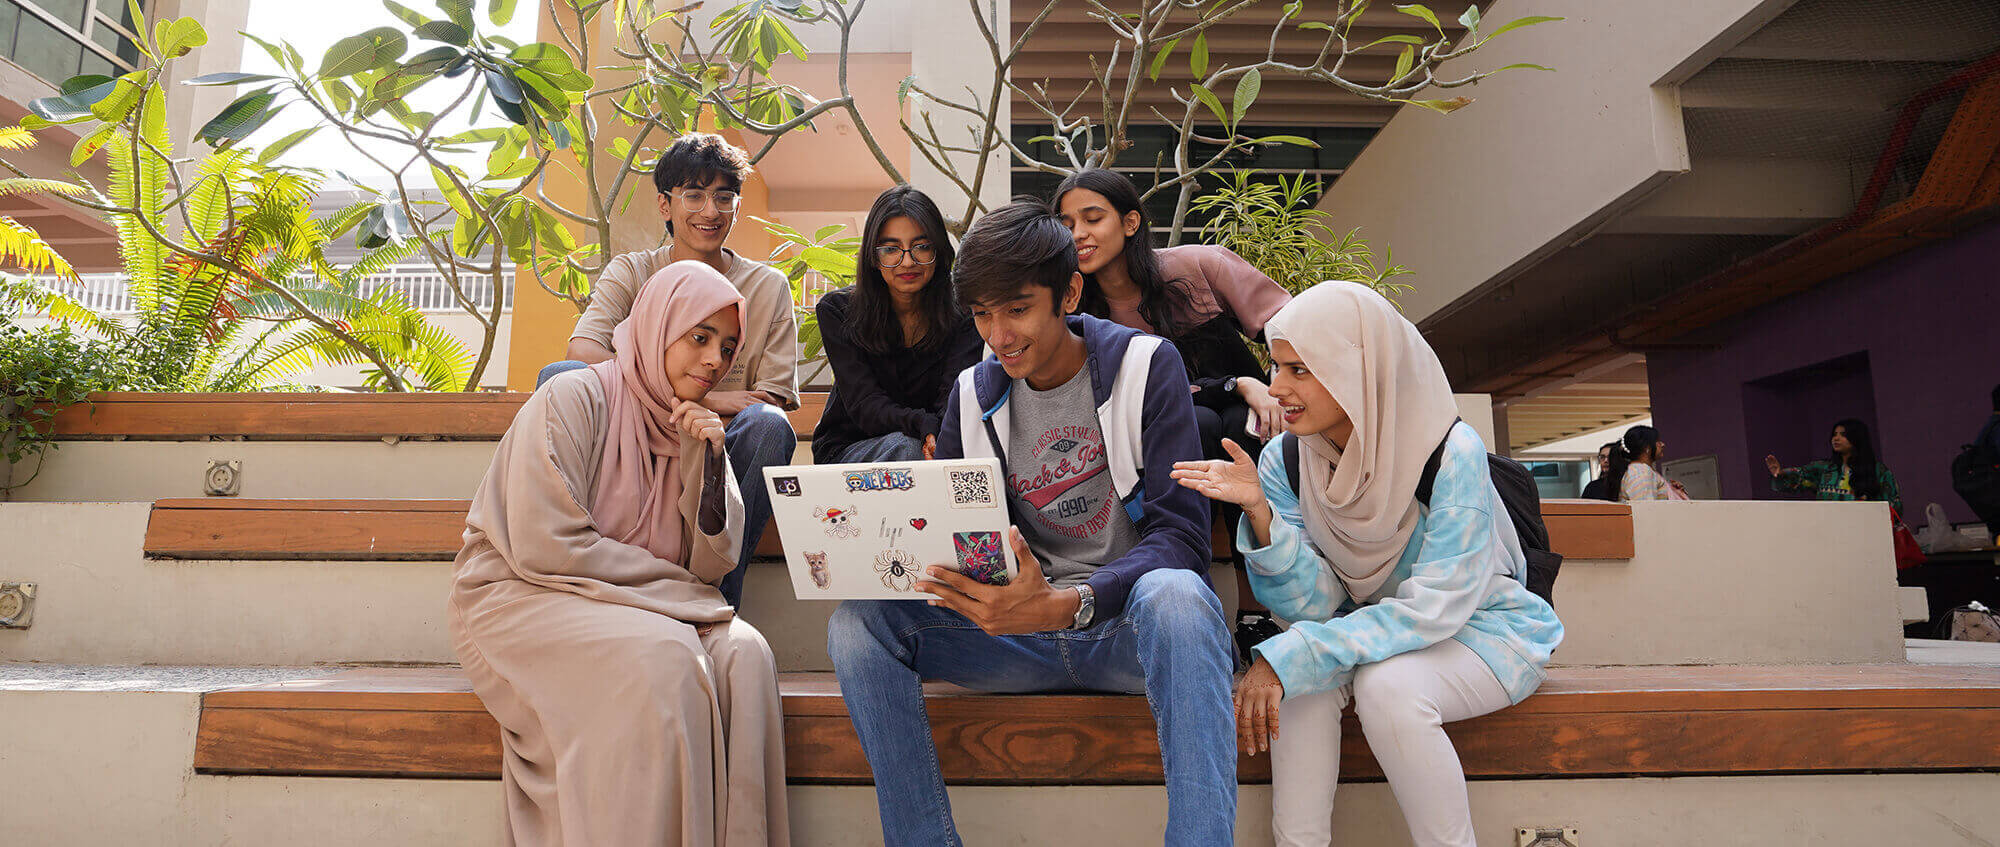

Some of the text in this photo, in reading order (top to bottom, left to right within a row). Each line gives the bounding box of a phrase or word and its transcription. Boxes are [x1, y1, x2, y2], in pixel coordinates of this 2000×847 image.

[1032, 428, 1062, 458] CLASSIC
[1007, 464, 1053, 497] Jack
[1054, 457, 1072, 479] &
[1036, 512, 1089, 540] SUPERIOR
[1086, 499, 1113, 536] DENIM
[1057, 496, 1089, 519] 1990
